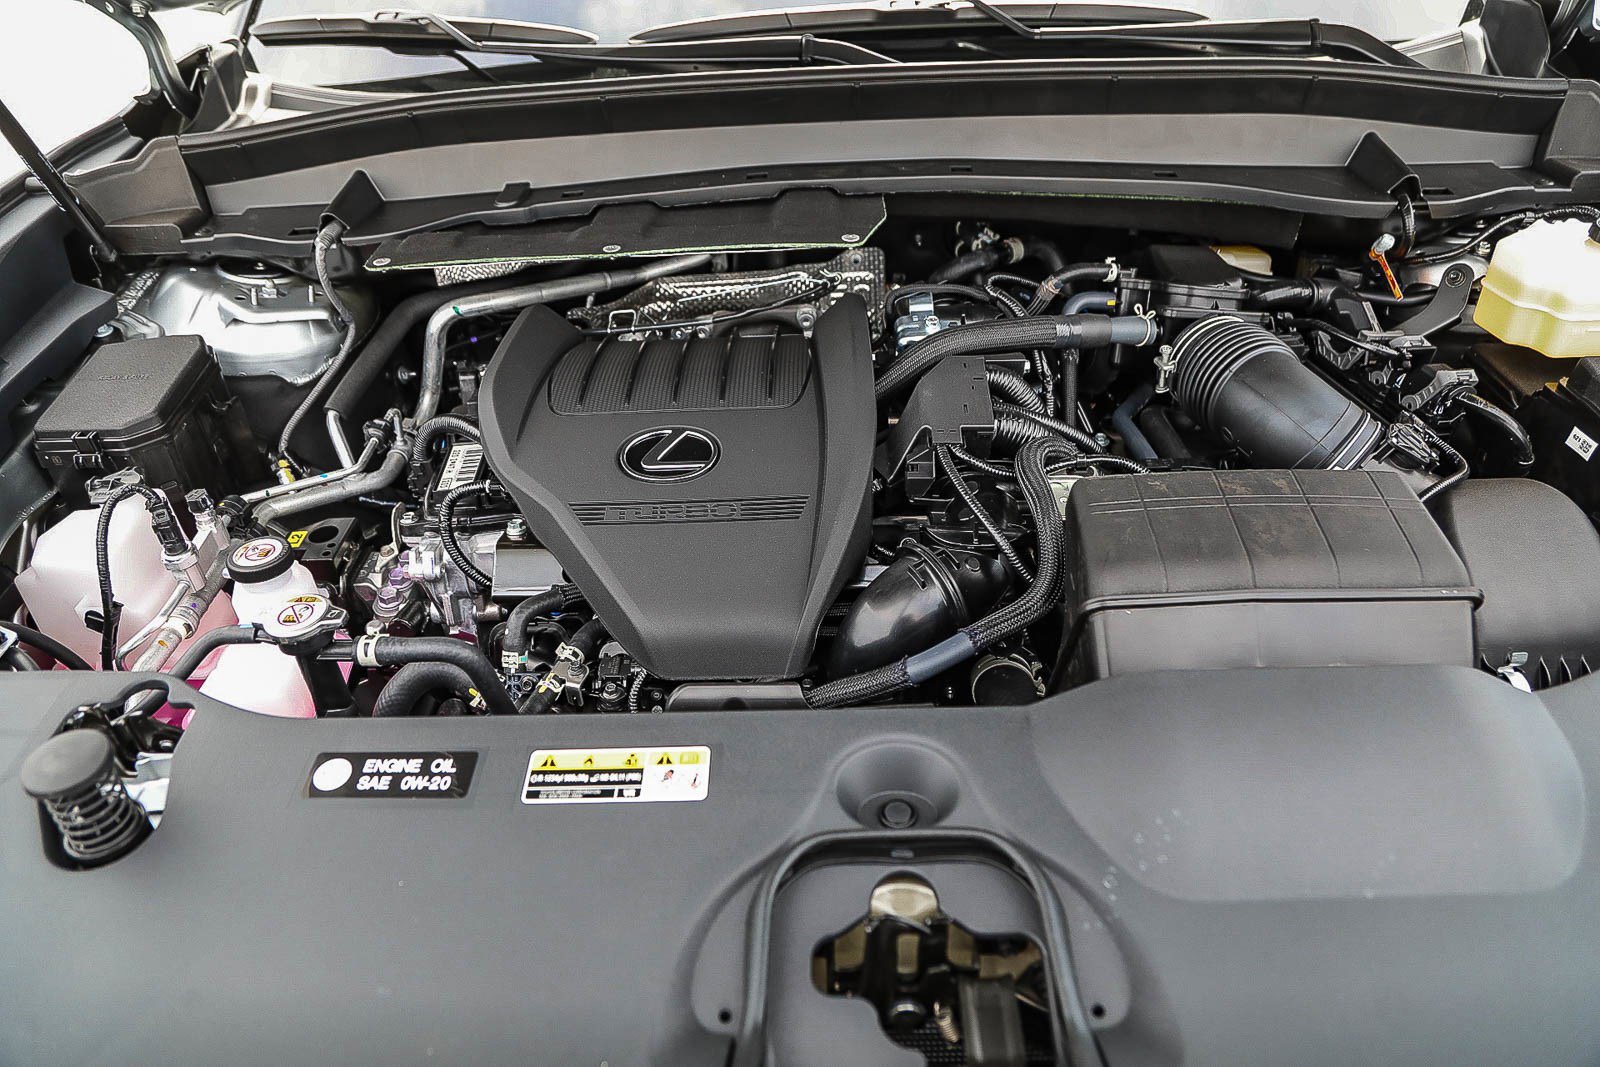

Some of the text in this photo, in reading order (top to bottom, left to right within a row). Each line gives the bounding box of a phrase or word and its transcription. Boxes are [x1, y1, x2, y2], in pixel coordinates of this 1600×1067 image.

[606, 502, 739, 520] TURBO
[362, 758, 456, 773] ENGINE OIL
[356, 775, 451, 790] SAE 0W-20
